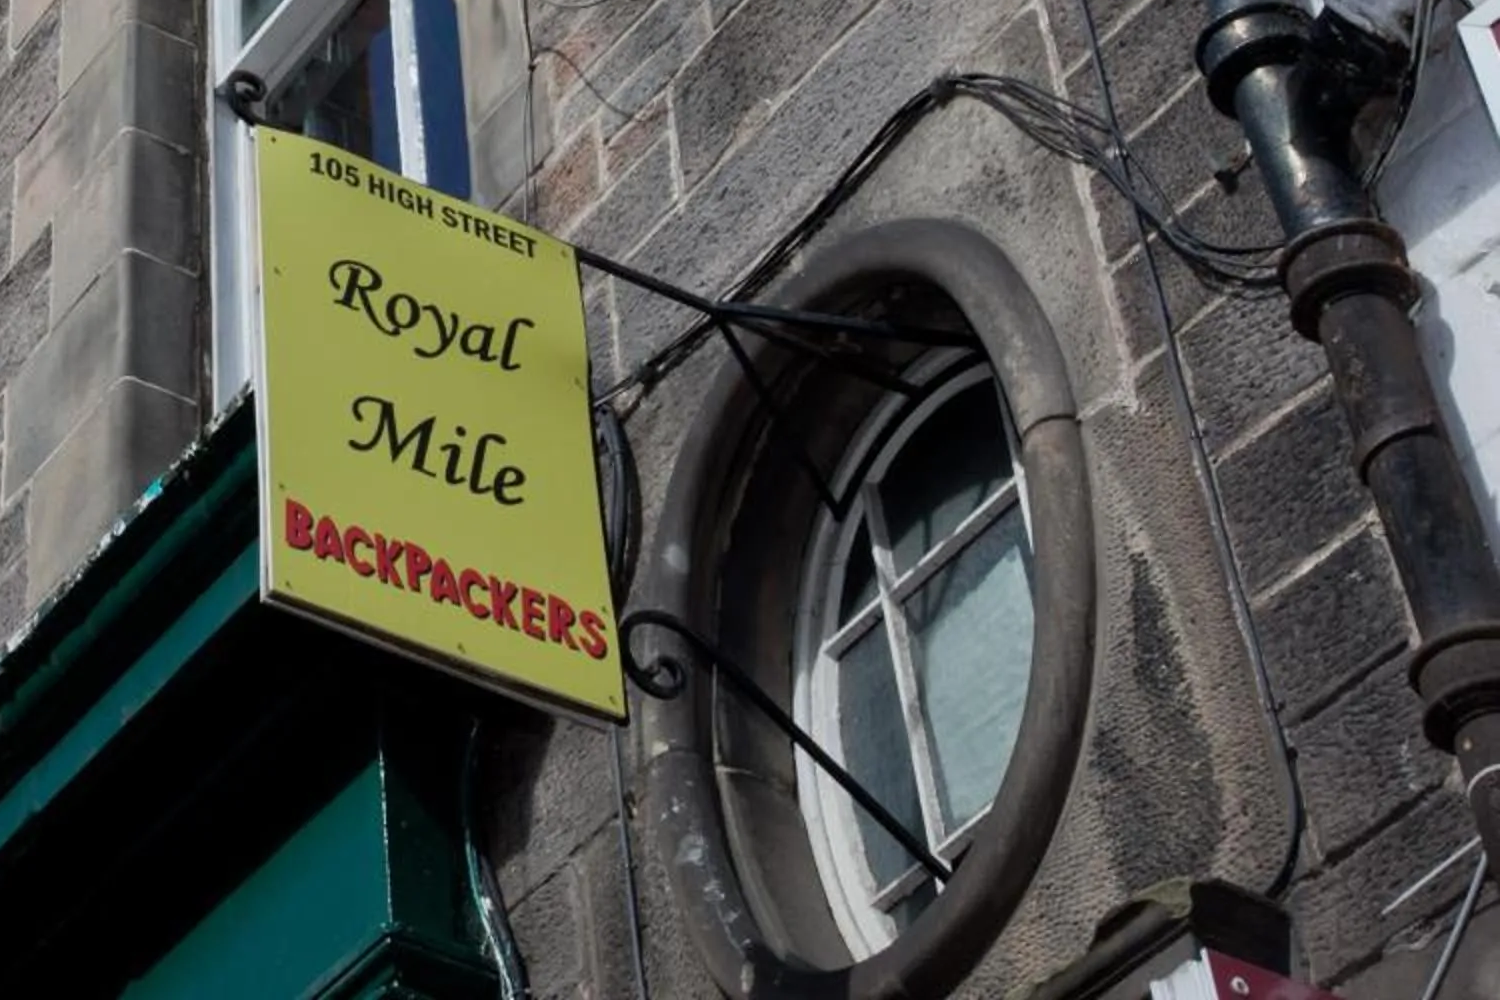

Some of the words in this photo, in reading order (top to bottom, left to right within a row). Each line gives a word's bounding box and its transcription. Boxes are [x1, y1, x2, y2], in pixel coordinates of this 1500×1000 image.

[310, 153, 360, 188] 105
[369, 174, 434, 219] HIGH
[442, 207, 537, 258] STREET
[329, 260, 535, 371] Royal
[348, 396, 526, 505] Mile
[285, 499, 608, 659] BACKPACKERS
